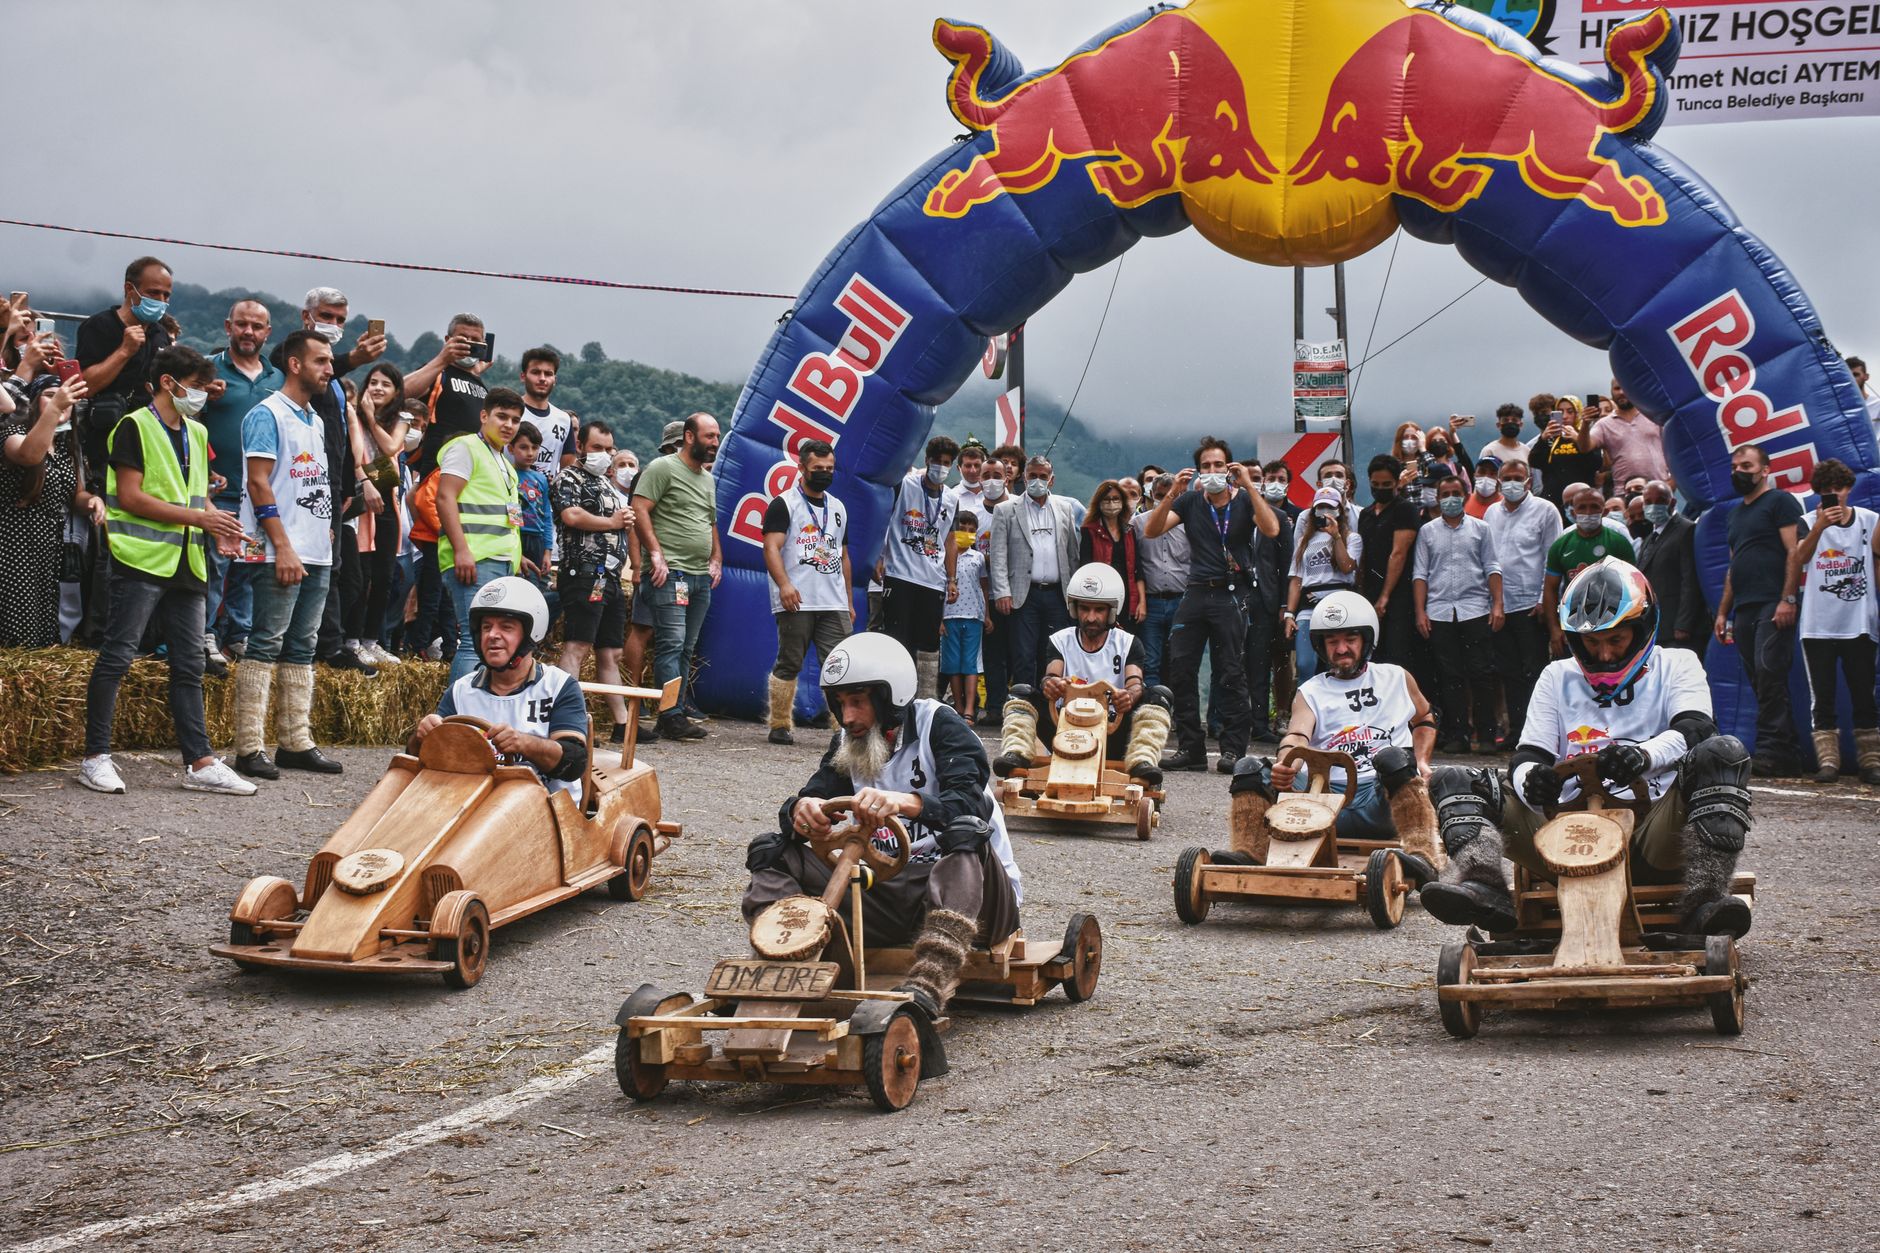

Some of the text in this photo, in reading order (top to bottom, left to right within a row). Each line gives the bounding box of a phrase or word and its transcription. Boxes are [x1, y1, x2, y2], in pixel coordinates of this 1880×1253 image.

[1731, 64, 1788, 87] Naci
[1793, 60, 1880, 84] AYTEM
[1676, 91, 1864, 112] Tunca Belediye Başkanı
[788, 274, 911, 422] Bull
[1313, 344, 1342, 354] D.E.M
[1306, 373, 1344, 385] Vaillant
[1669, 290, 1808, 451] Red
[450, 377, 488, 399] OUTSID
[552, 424, 566, 442] 43
[835, 512, 842, 528] 6
[1309, 558, 1331, 567] adida
[1816, 559, 1851, 570] Red Bull
[1112, 654, 1121, 675] 9
[1345, 687, 1378, 712] 33
[527, 697, 554, 724] 15
[1348, 729, 1373, 742] Bull
[910, 756, 927, 790] 3
[1564, 844, 1594, 856] 40
[776, 930, 792, 945] 3
